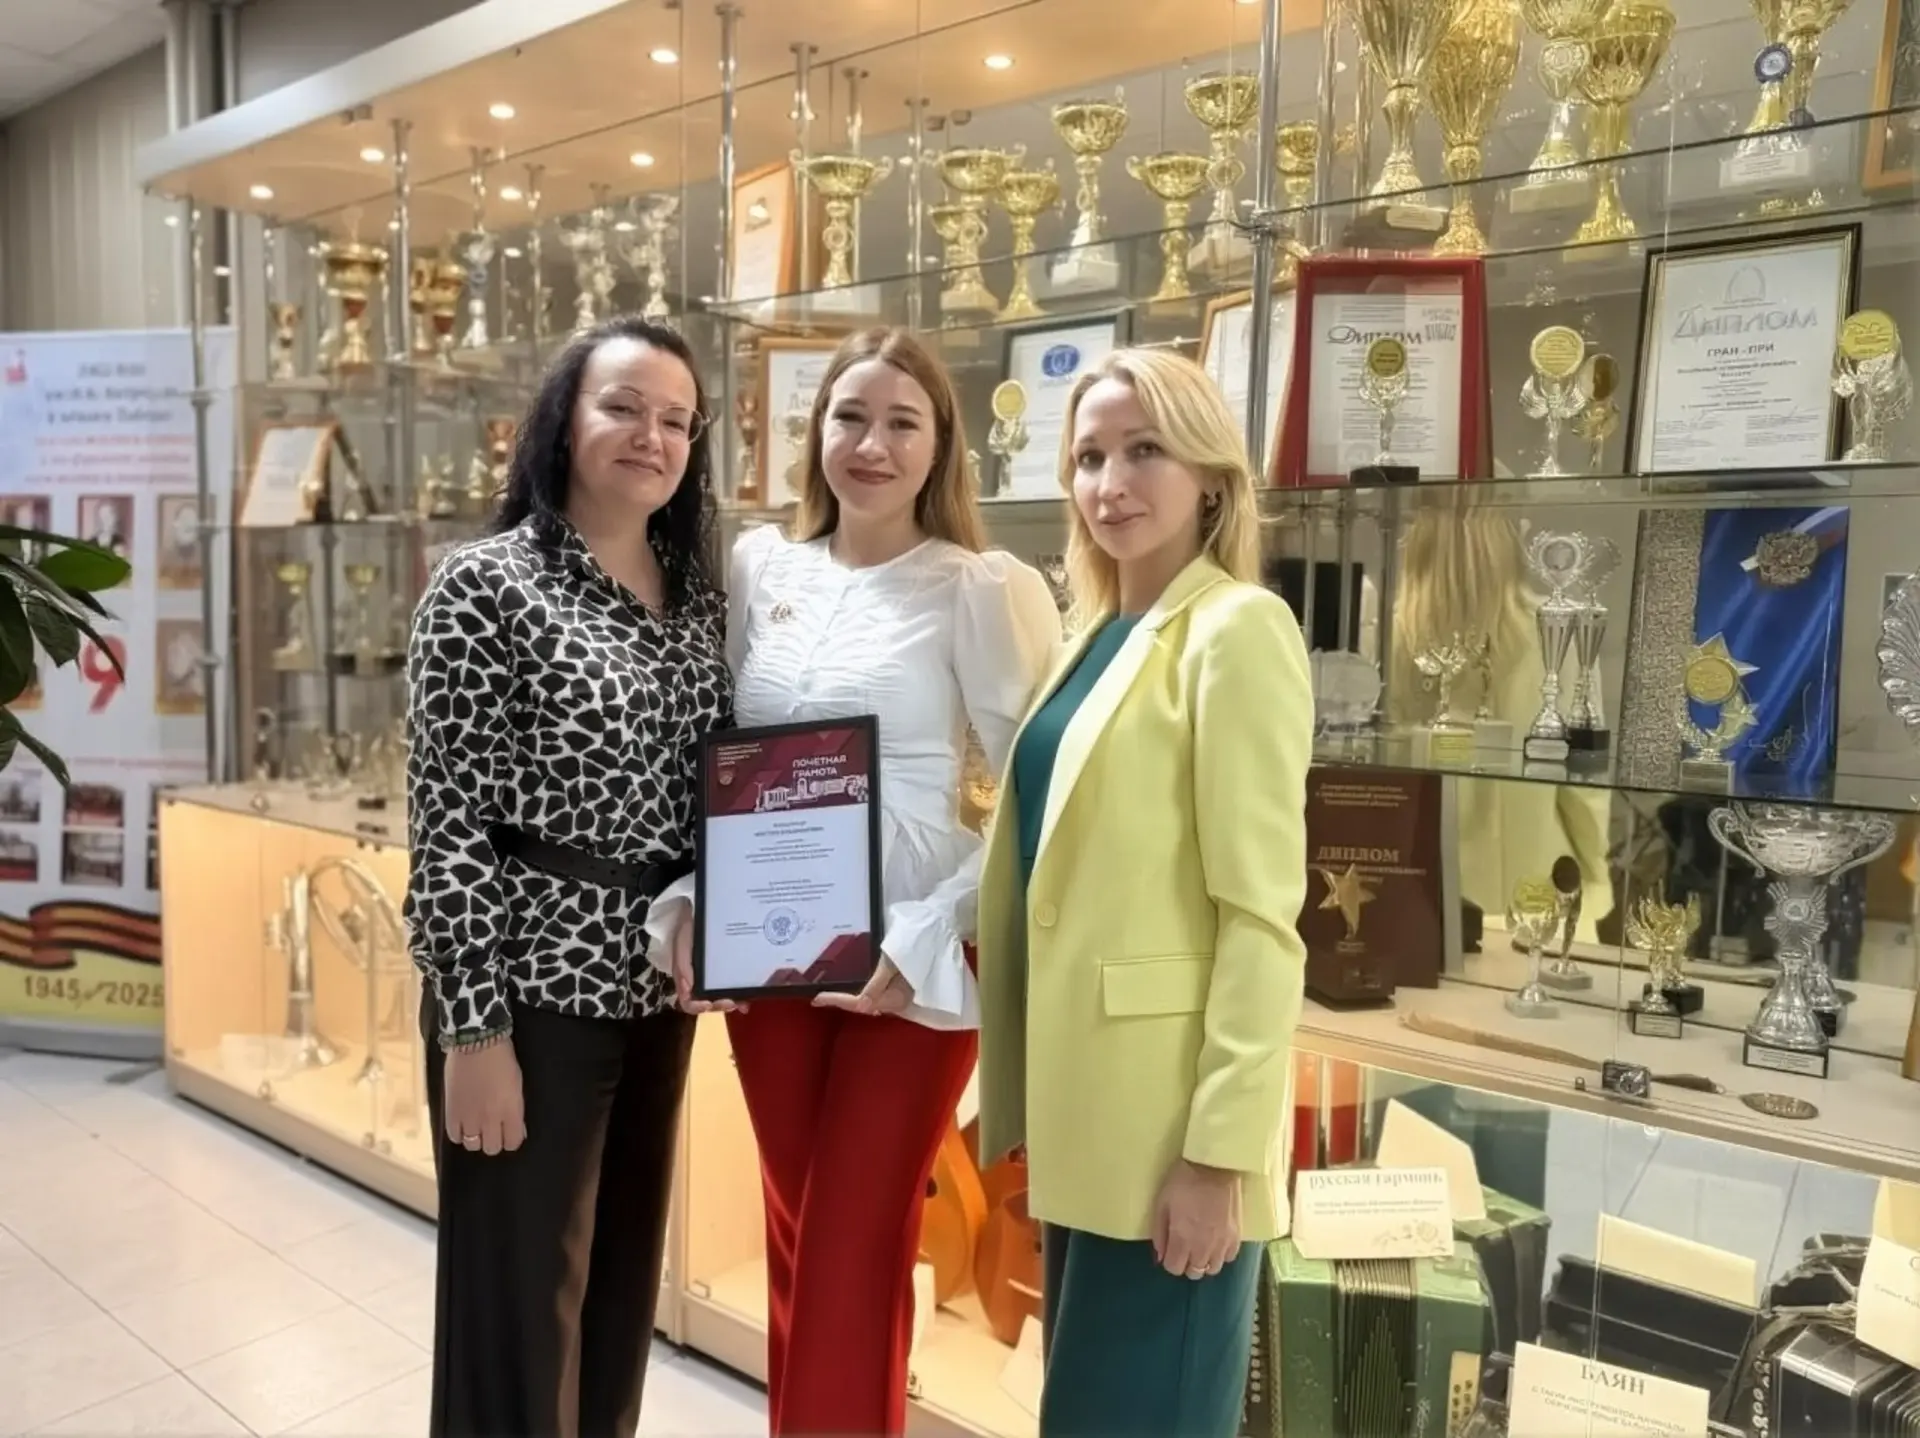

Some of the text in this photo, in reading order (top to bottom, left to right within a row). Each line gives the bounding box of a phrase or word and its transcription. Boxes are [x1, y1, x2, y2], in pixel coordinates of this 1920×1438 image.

[1707, 347, 1738, 357] ГРАН
[1748, 343, 1774, 354] ПРИ
[792, 755, 847, 768] ПОЧЕТНАЯ
[792, 768, 838, 778] ГРАМОТА
[1316, 846, 1399, 862] ДИПЛОМ
[1310, 1173, 1370, 1190] русская
[1581, 1364, 1645, 1395] БАЯН
